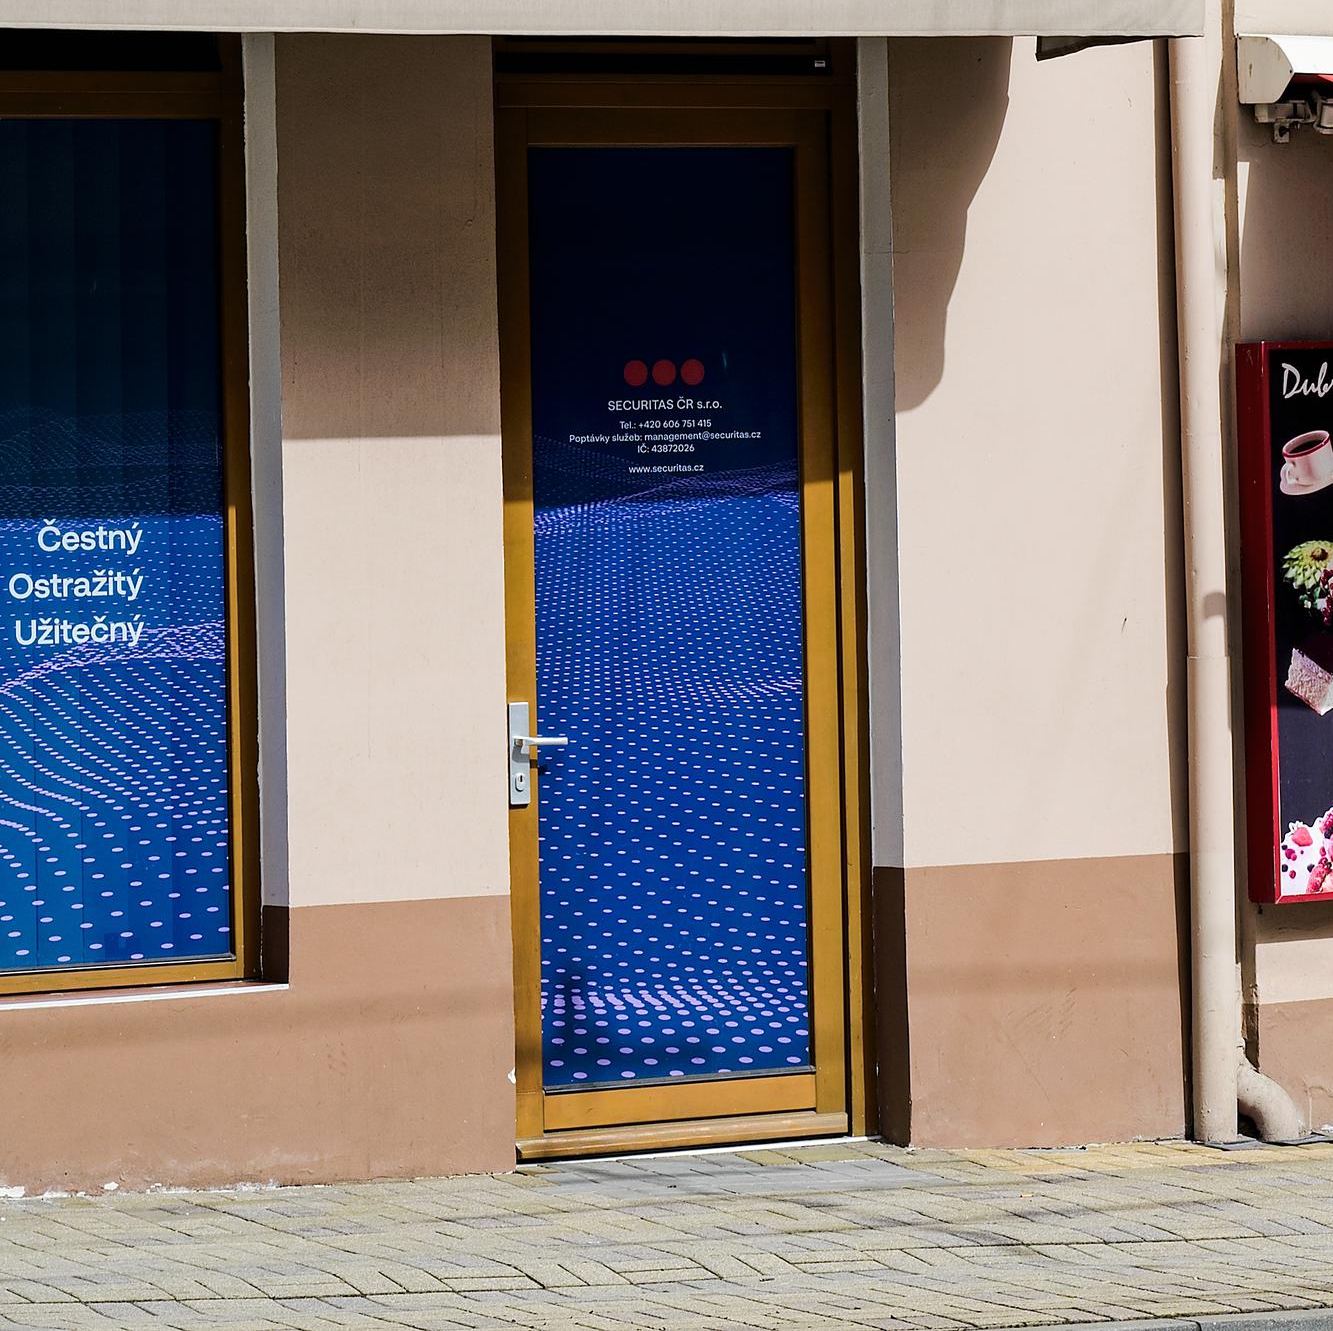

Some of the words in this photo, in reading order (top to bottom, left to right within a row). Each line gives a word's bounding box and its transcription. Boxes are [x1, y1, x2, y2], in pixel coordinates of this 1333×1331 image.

[607, 400, 674, 411] SECURITAS
[676, 396, 694, 410] ČR
[696, 400, 723, 409] s.r.o.
[619, 421, 637, 430] Tel.:
[638, 420, 661, 429] +420
[662, 419, 680, 429] 606
[681, 419, 696, 428] 751
[697, 419, 712, 428] 415
[569, 433, 610, 444] Poptávky
[611, 433, 643, 442] služeb:
[644, 430, 762, 443] management@securitas.cz
[637, 443, 650, 454] IČ:
[651, 444, 696, 453] 43872026
[628, 463, 705, 474] www.securitas.cz
[37, 518, 144, 556] Čestný
[8, 567, 144, 601] Ostražitý
[14, 613, 145, 648] Užitečný
